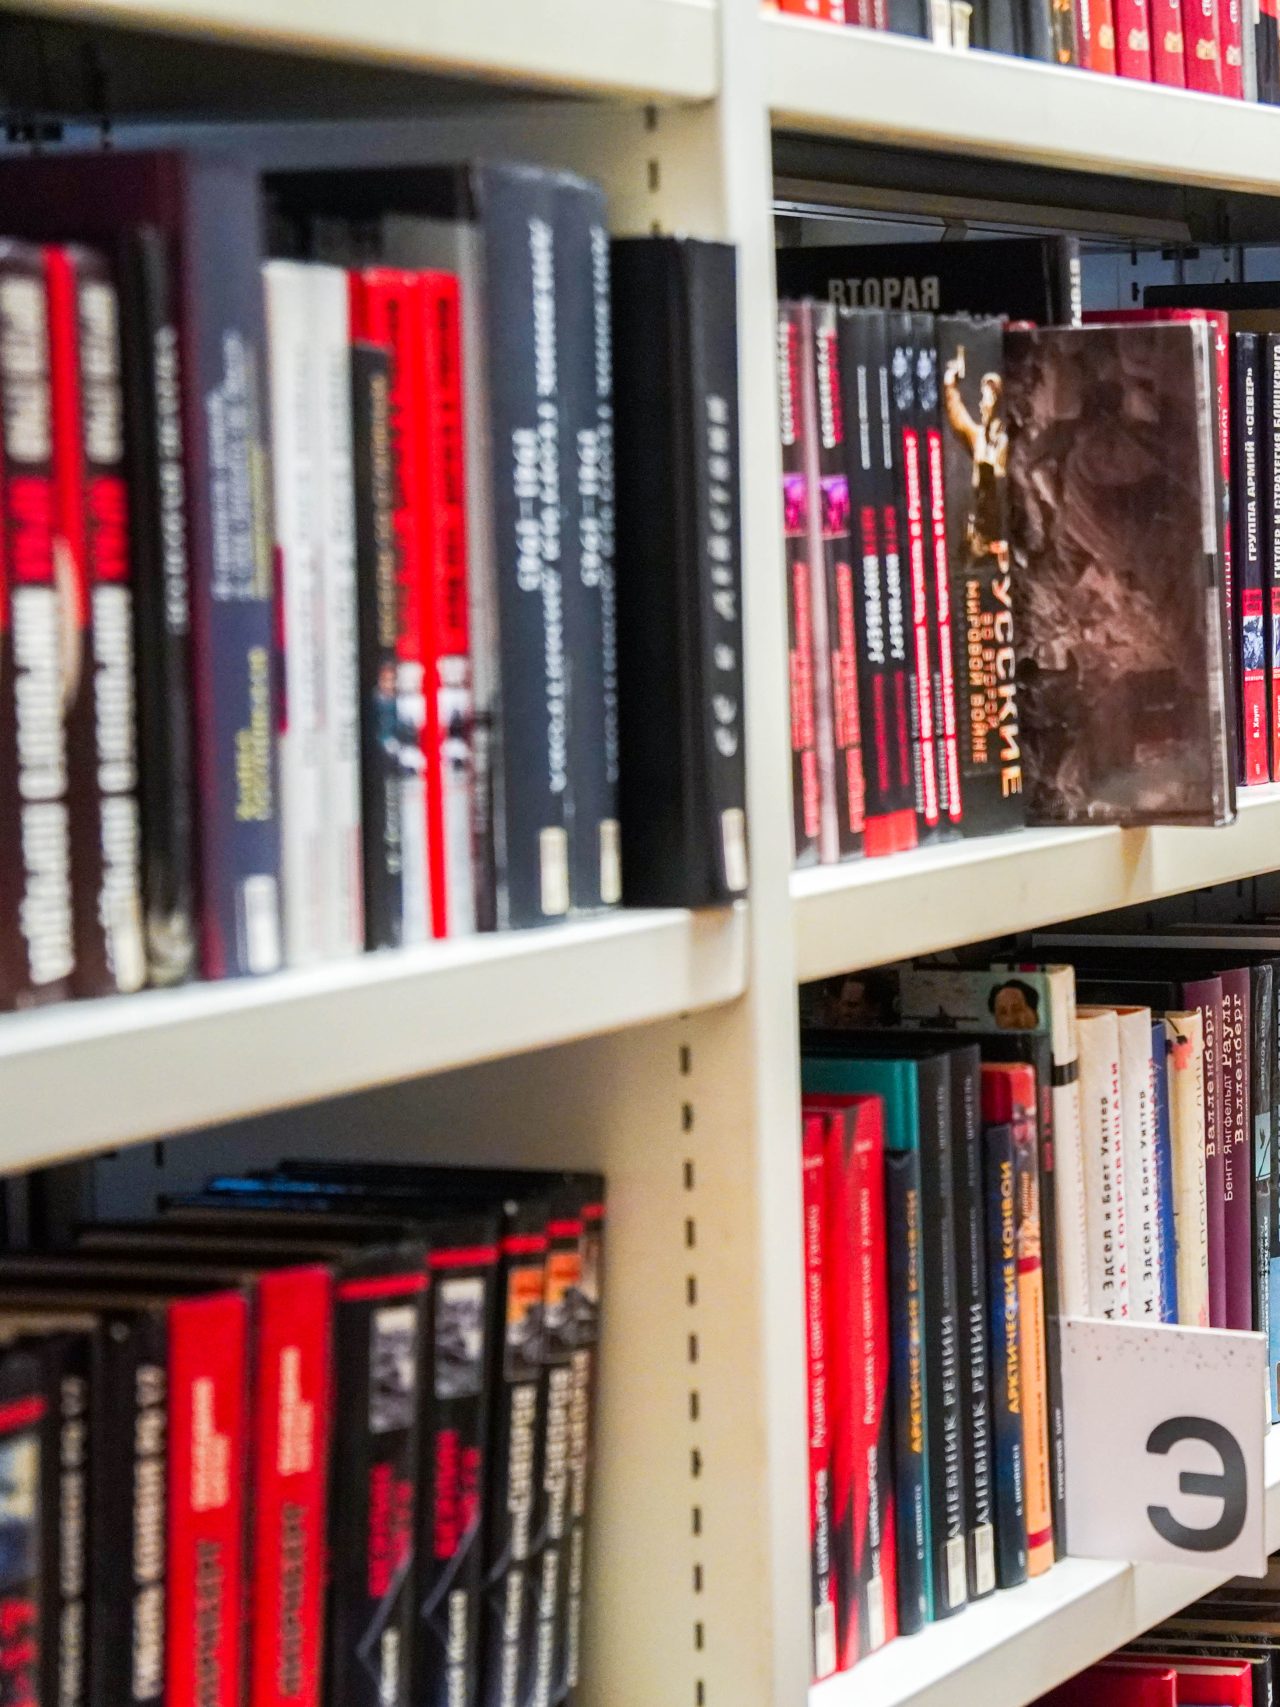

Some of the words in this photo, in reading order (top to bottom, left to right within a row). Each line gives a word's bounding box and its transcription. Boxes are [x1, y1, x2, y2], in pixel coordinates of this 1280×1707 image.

[828, 276, 940, 311] ВТОРАЯ
[1245, 367, 1256, 436] «СЕВЕР»
[1244, 440, 1256, 499] АРМИЙ
[1246, 500, 1258, 562] ГРУППА
[990, 540, 1023, 798] РУССКИЕ
[1220, 994, 1233, 1068] Рауль
[1202, 1004, 1217, 1159] Валленберг
[1232, 993, 1245, 1144] Валленберг
[1099, 1096, 1109, 1158] Уиттер
[1138, 1091, 1148, 1150] Уиттер
[1222, 1074, 1234, 1154] Янгфельдт
[1101, 1163, 1111, 1204] Брет
[1140, 1157, 1149, 1196] Брет
[1223, 1158, 1234, 1201] Бенгт
[1000, 1161, 1014, 1258] КОНВОИ
[1102, 1229, 1115, 1291] Эдсел
[1141, 1221, 1153, 1282] Эдсел
[1145, 1415, 1248, 1553] Э
